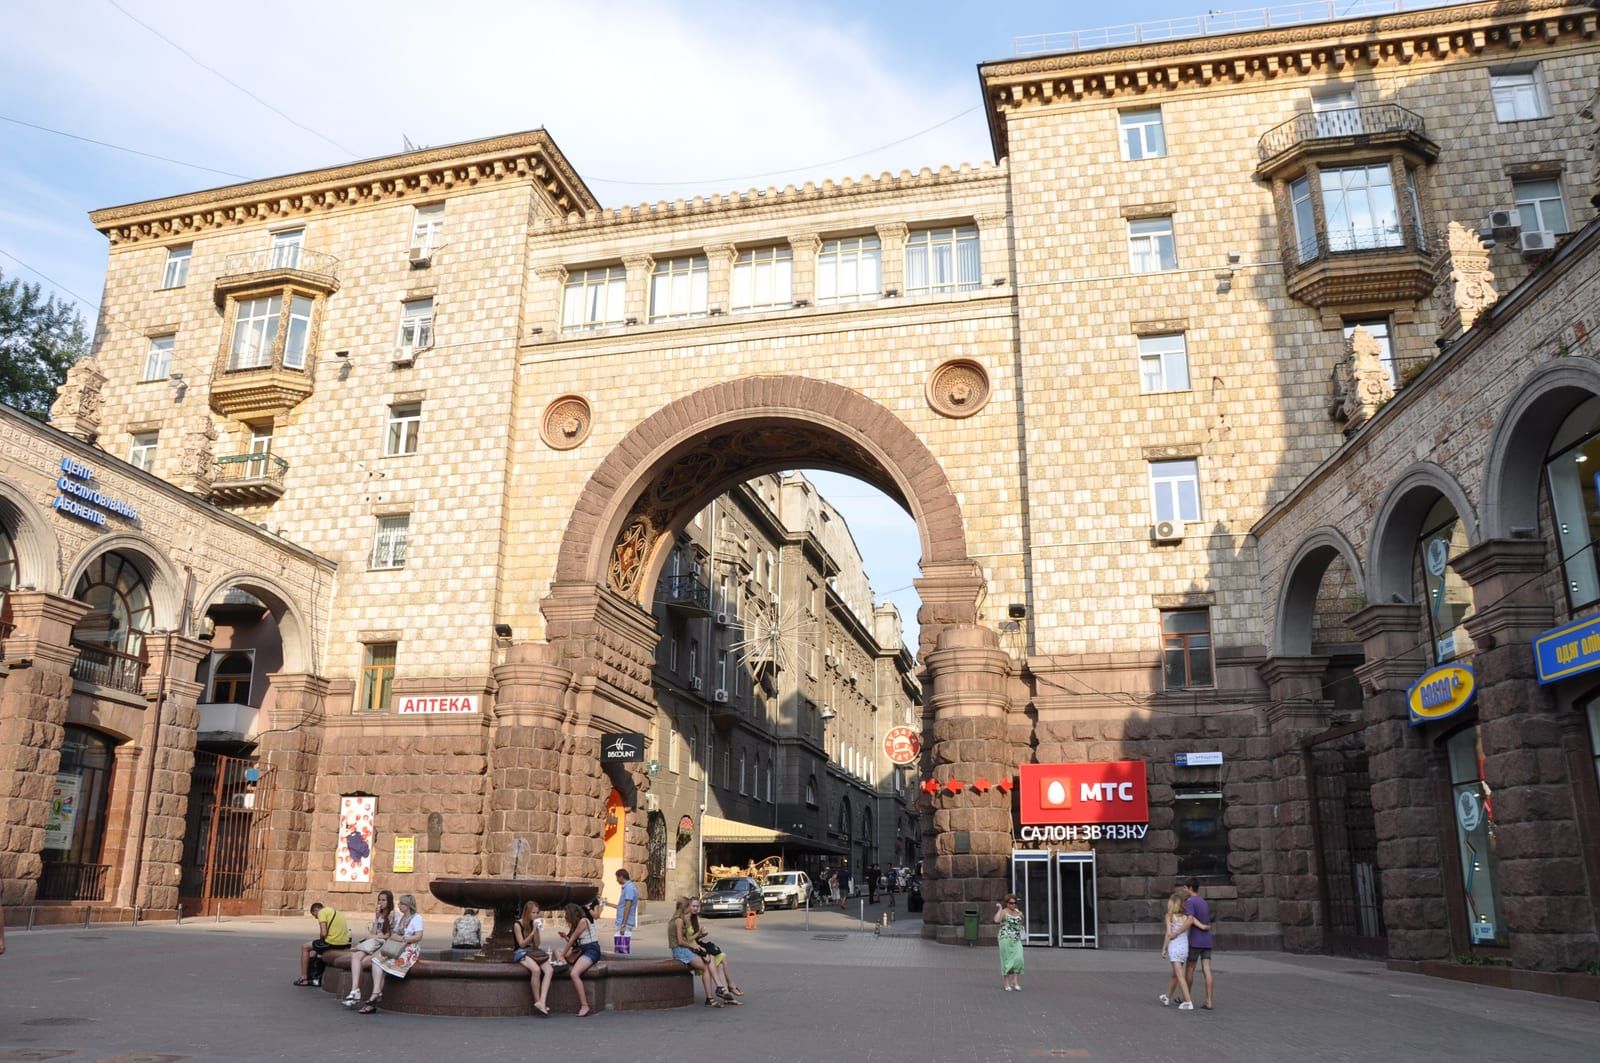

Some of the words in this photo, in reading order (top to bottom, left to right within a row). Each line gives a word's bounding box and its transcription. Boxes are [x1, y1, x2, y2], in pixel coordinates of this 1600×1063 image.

[61, 458, 95, 480] ЦЕНТР
[58, 477, 138, 519] ОБСЛУГОВУВАННЯ
[54, 496, 107, 525] АБОНЕНТІВ
[1555, 640, 1579, 664] ОДЯГ
[1421, 676, 1453, 709] BOSCO
[403, 697, 472, 713] АПТЕКА
[606, 750, 636, 759] DISCOUNT
[1080, 782, 1134, 801] МТС
[1020, 825, 1077, 841] САЛОН
[1081, 823, 1149, 840] ЗВ'ЯЗКУ
